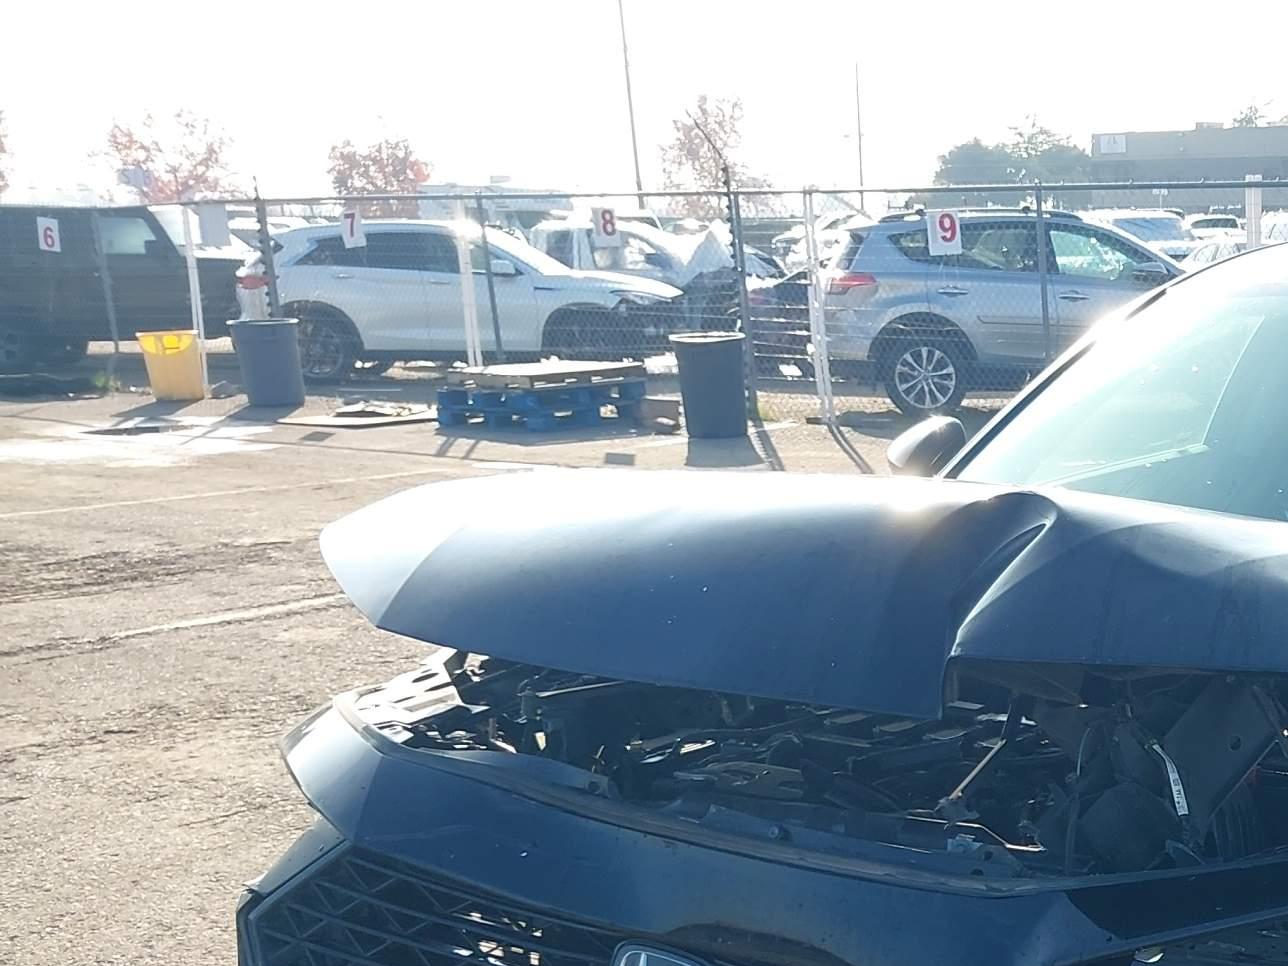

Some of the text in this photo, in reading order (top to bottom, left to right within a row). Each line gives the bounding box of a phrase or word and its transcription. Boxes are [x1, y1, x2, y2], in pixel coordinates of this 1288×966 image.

[343, 213, 356, 238] 7
[601, 209, 616, 236] 8
[938, 213, 957, 243] 9
[43, 226, 55, 248] 6
